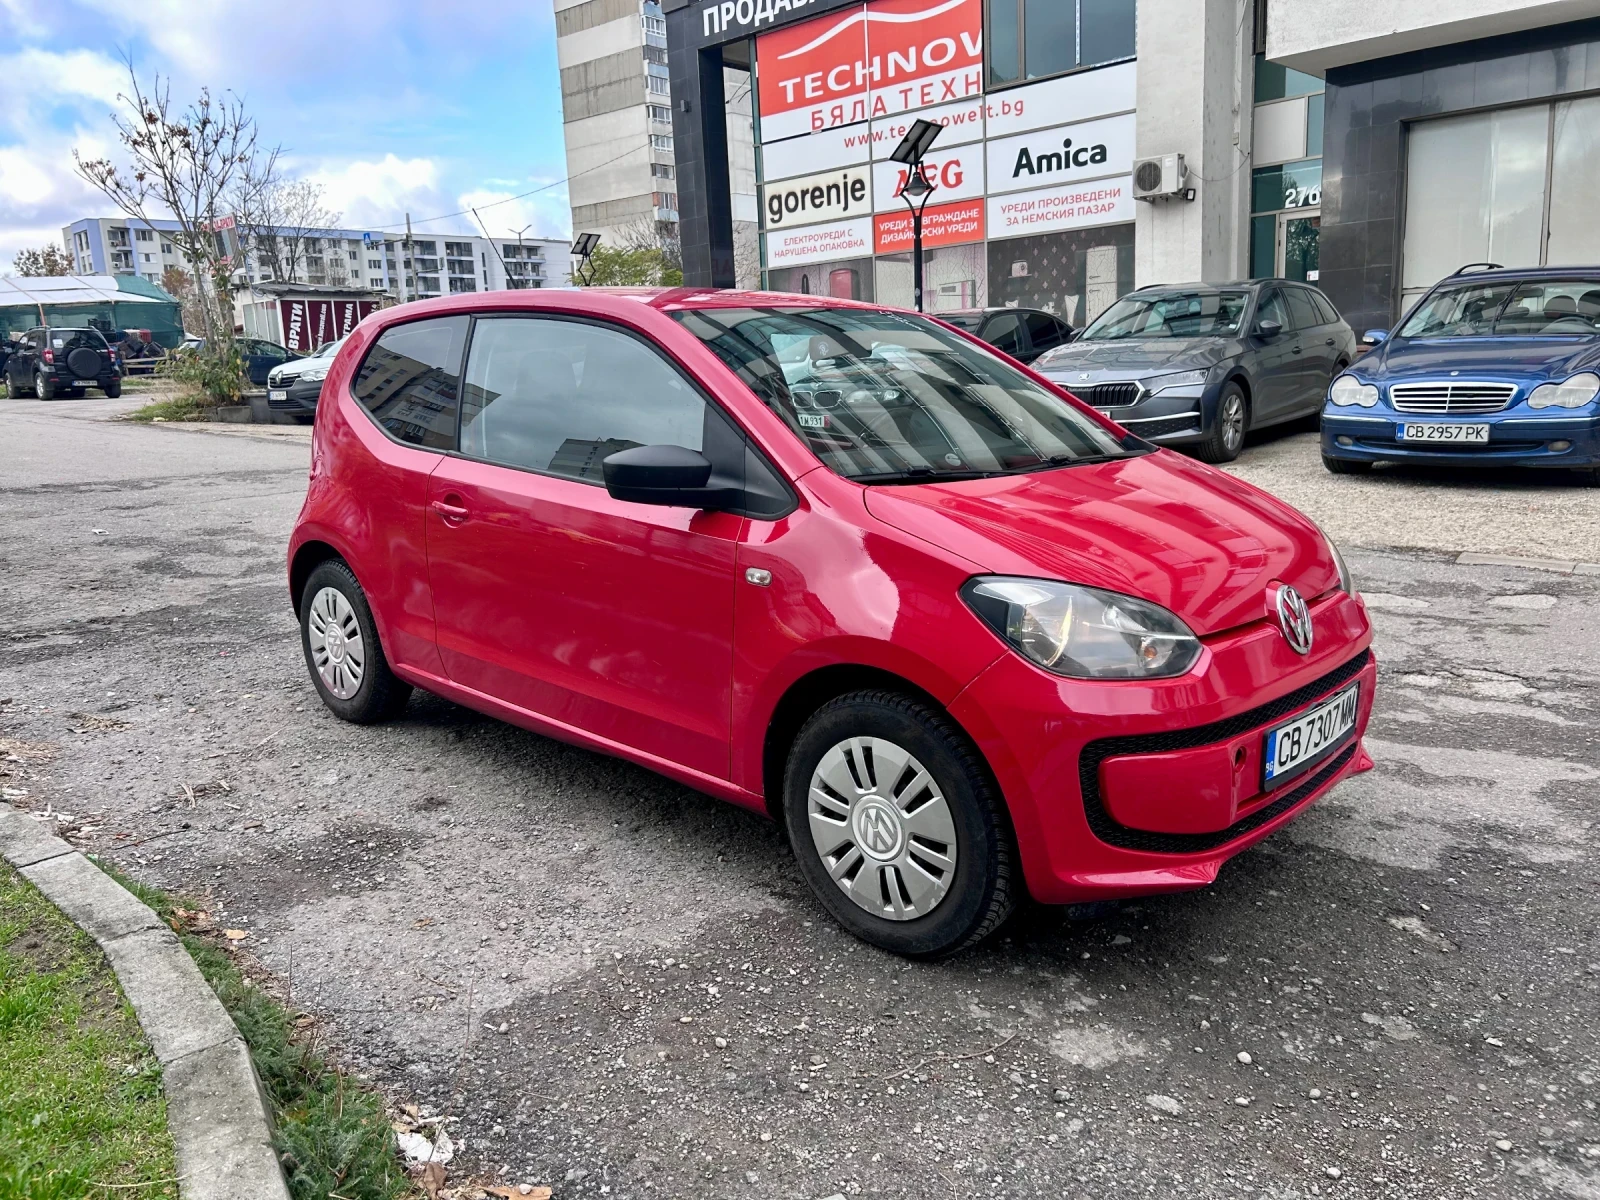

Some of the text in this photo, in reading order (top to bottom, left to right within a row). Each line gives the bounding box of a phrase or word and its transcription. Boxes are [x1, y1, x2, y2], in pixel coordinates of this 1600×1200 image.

[811, 95, 887, 131] БЯЛА
[844, 100, 1024, 148] www.teowelt.bg
[1012, 138, 1107, 178] Amica
[768, 173, 865, 224] gorenje
[1001, 188, 1120, 214] УРЕДИ ПРОИЗВЕДЕНИ
[879, 219, 907, 231] УРЕДИ
[922, 208, 979, 225] ВГРАЖДАНЕ
[1006, 202, 1115, 227] ЗА НЕМСКИЯ ПАЗАР
[784, 231, 846, 246] ЕЛЕКТРОУРЕДИ
[881, 221, 977, 244] ДИЗАЙНРСКИ УРЕДИ
[774, 238, 865, 258] НАРУШЕНА ОПАКОВКА
[288, 302, 303, 349] ВРАТИ
[1406, 425, 1485, 439] CB 2957 PK
[1278, 726, 1302, 767] CB
[1304, 702, 1340, 755] 7307
